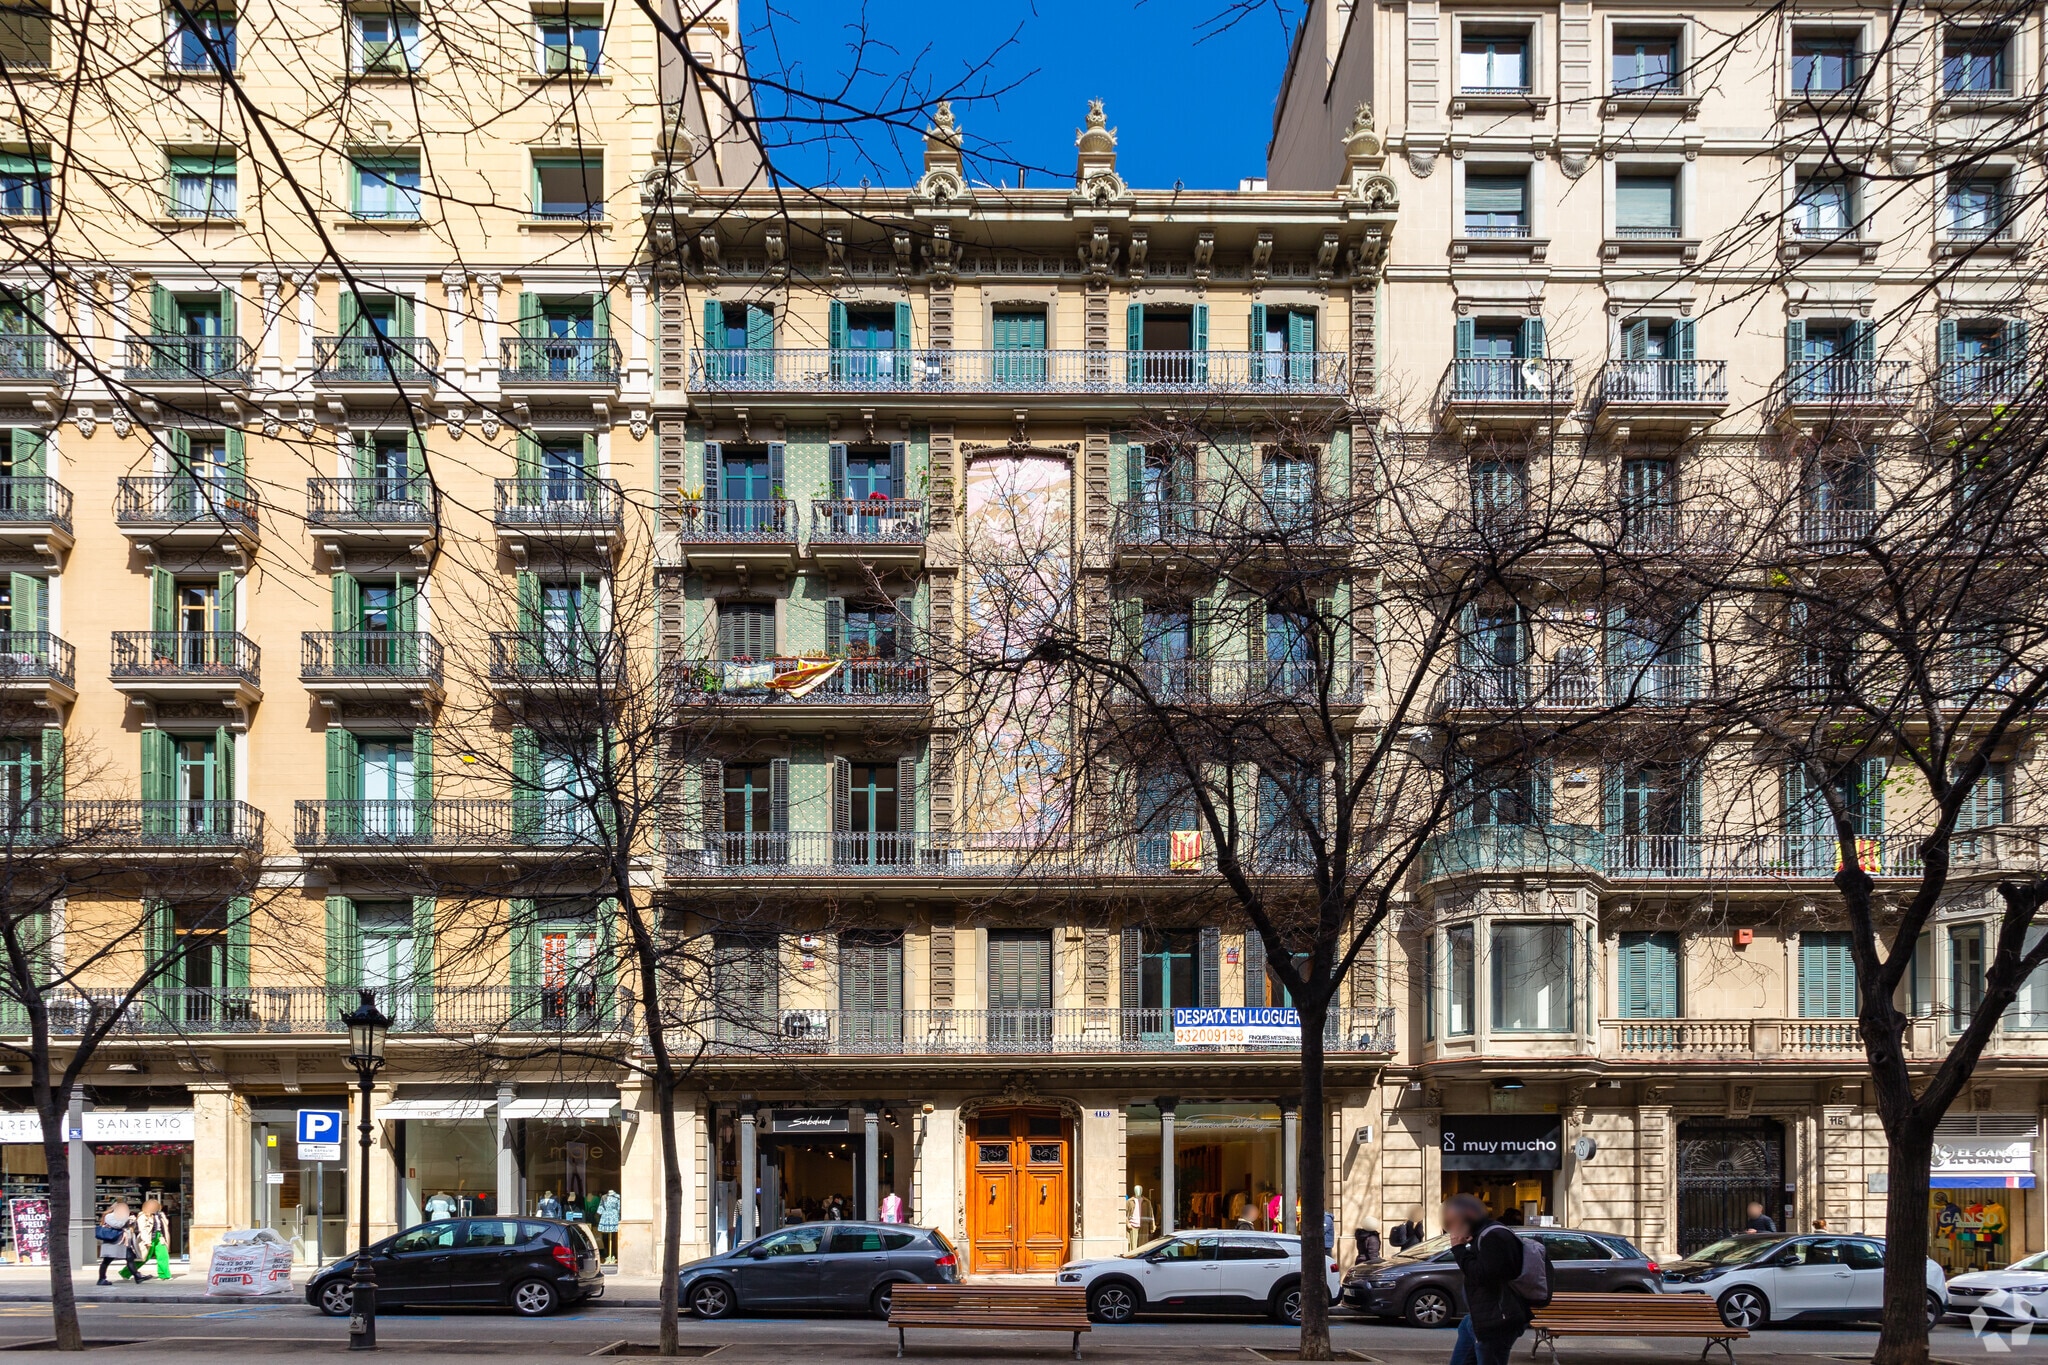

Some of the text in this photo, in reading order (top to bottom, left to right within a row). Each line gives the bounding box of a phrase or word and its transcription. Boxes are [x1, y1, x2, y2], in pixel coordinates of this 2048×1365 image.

[1177, 1008, 1228, 1025] DESPATX
[1230, 1008, 1246, 1024] EN
[1176, 1028, 1244, 1043] 932009198
[97, 1118, 182, 1129] SANREMO
[306, 1114, 332, 1140] P
[788, 1115, 833, 1128] Subdued
[550, 1144, 604, 1161] maje
[1463, 1138, 1557, 1153] muy mucho
[1957, 1148, 1973, 1157] EL
[1940, 1211, 1998, 1225] GANSO
